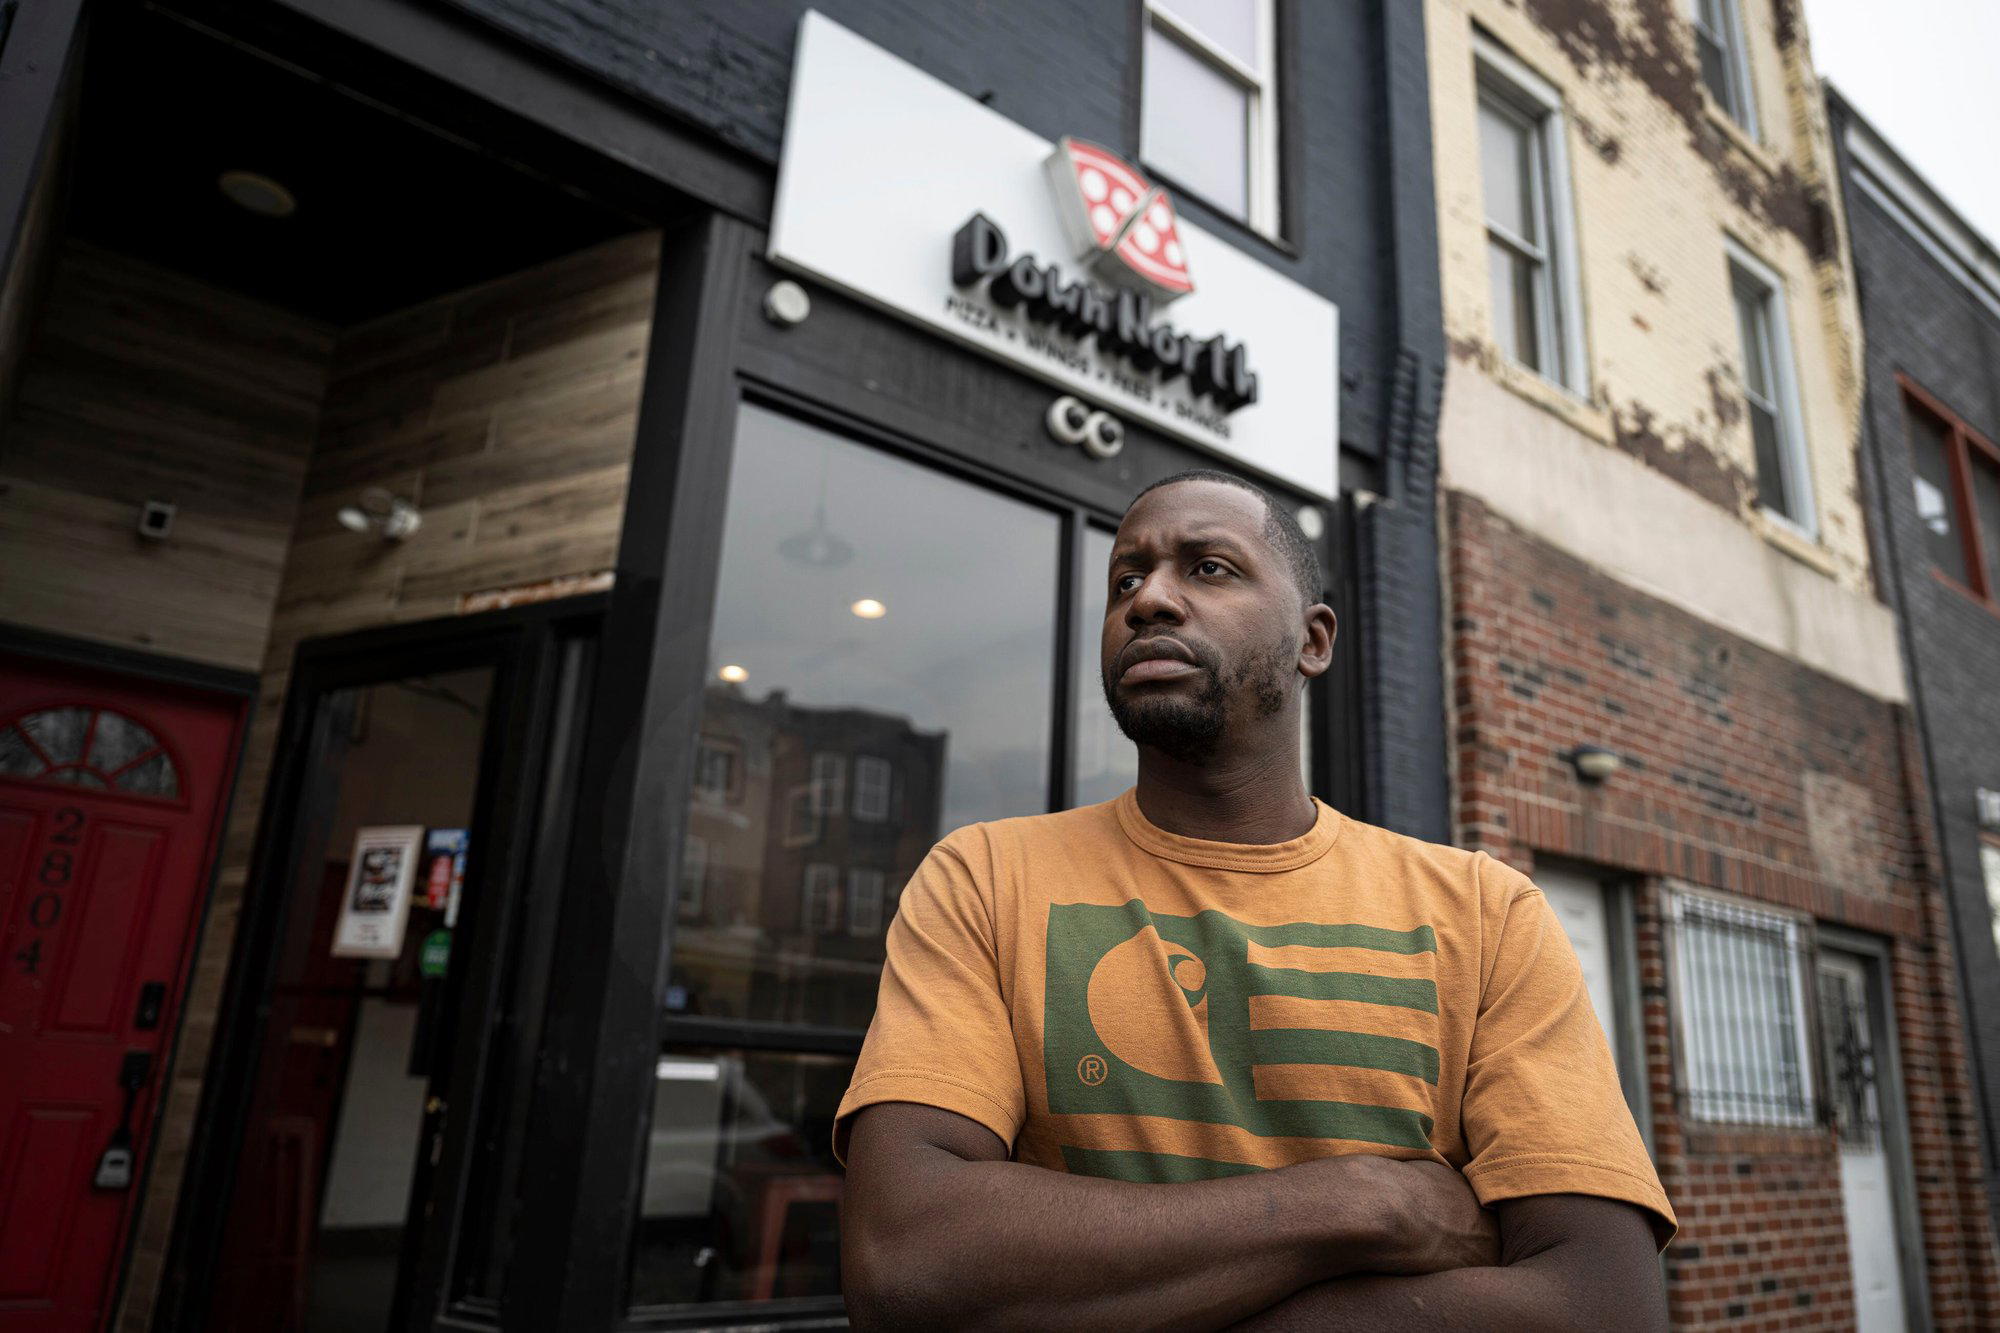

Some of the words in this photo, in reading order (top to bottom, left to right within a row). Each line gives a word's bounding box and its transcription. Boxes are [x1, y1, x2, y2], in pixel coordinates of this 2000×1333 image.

[945, 297, 999, 331] PIZZA
[1116, 290, 1258, 405] North
[15, 806, 85, 975] 2804
